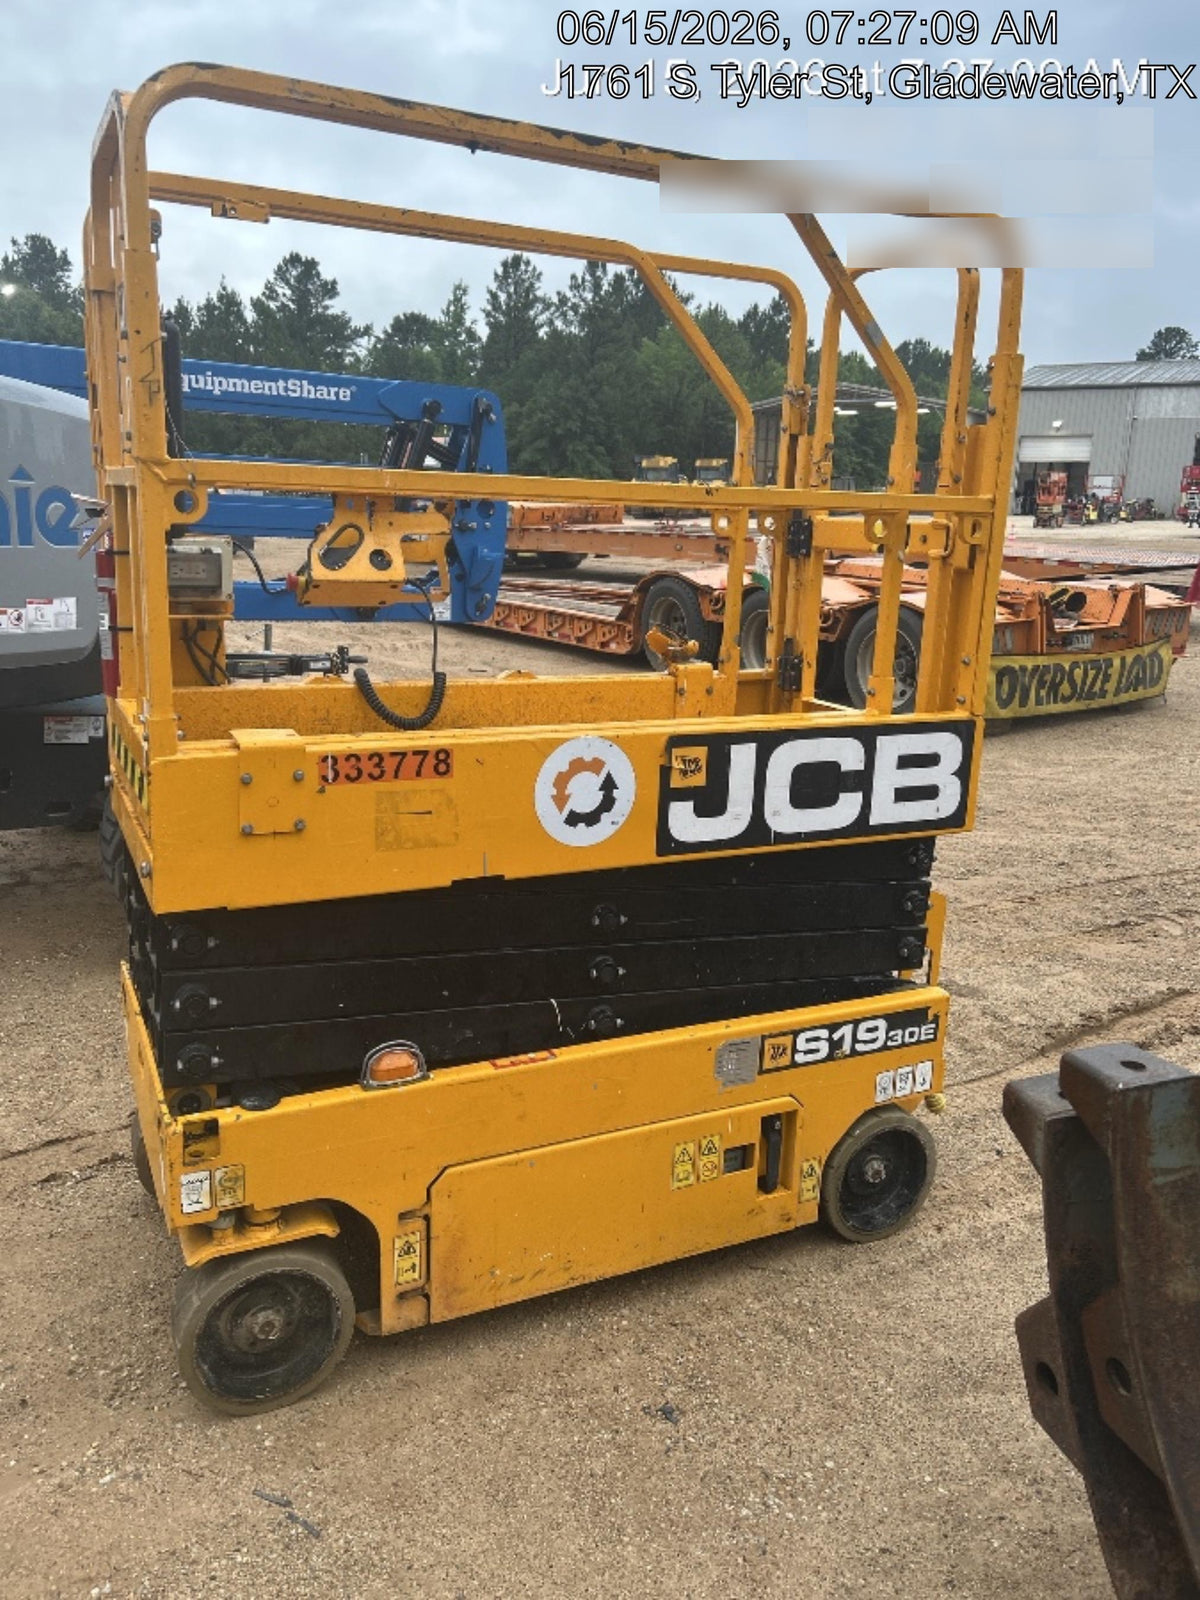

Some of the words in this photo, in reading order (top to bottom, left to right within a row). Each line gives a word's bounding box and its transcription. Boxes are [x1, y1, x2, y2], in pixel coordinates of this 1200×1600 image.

[180, 371, 352, 401] quipmentShare
[995, 656, 1114, 710] OVERSIZE
[320, 748, 451, 783] 333778
[668, 731, 964, 843] JCB
